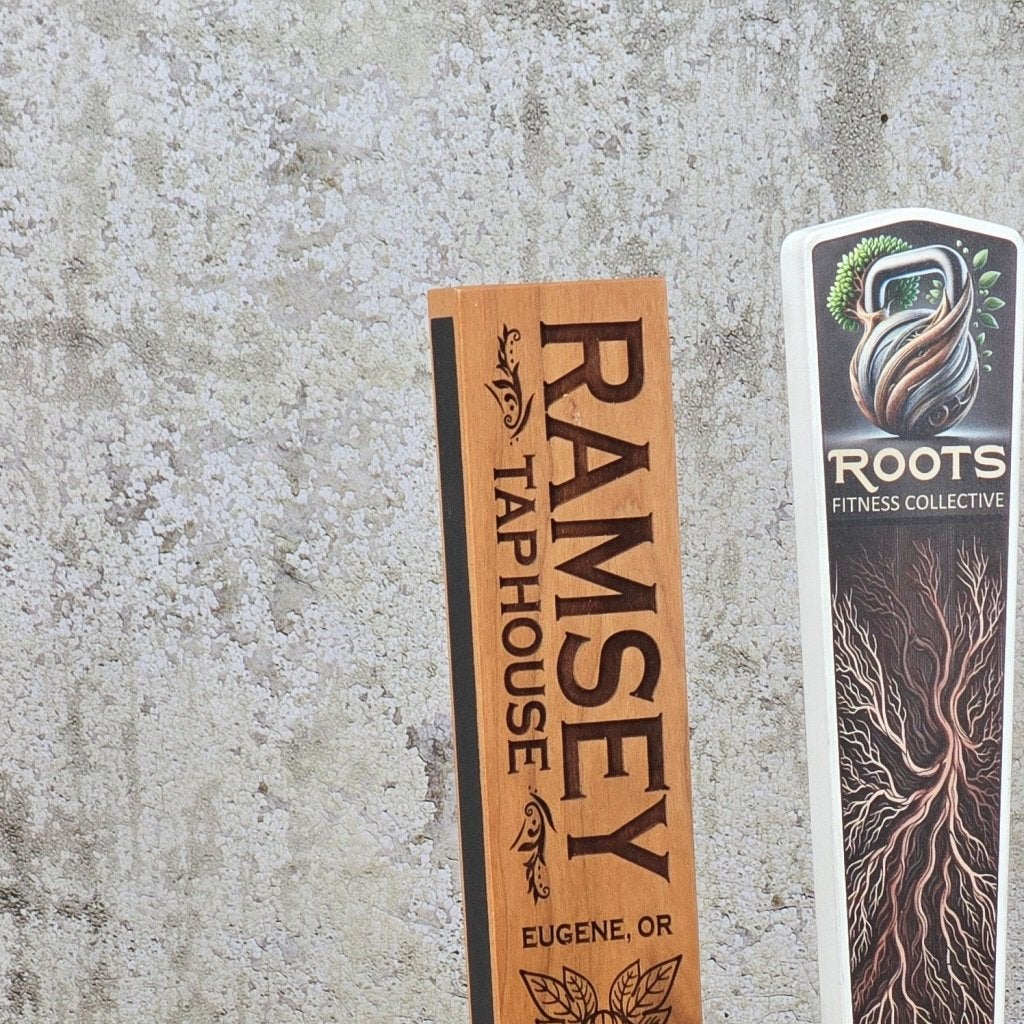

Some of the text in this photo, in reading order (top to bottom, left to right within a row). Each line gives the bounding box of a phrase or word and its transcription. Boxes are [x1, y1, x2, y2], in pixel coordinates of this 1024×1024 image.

[827, 444, 1006, 493] ROOTS
[832, 492, 1005, 513] FITNESS COLLECTIVE
[493, 454, 551, 774] TAPHOUSE
[540, 317, 670, 883] RAMSEY
[522, 914, 673, 948] EUGENE, OR
